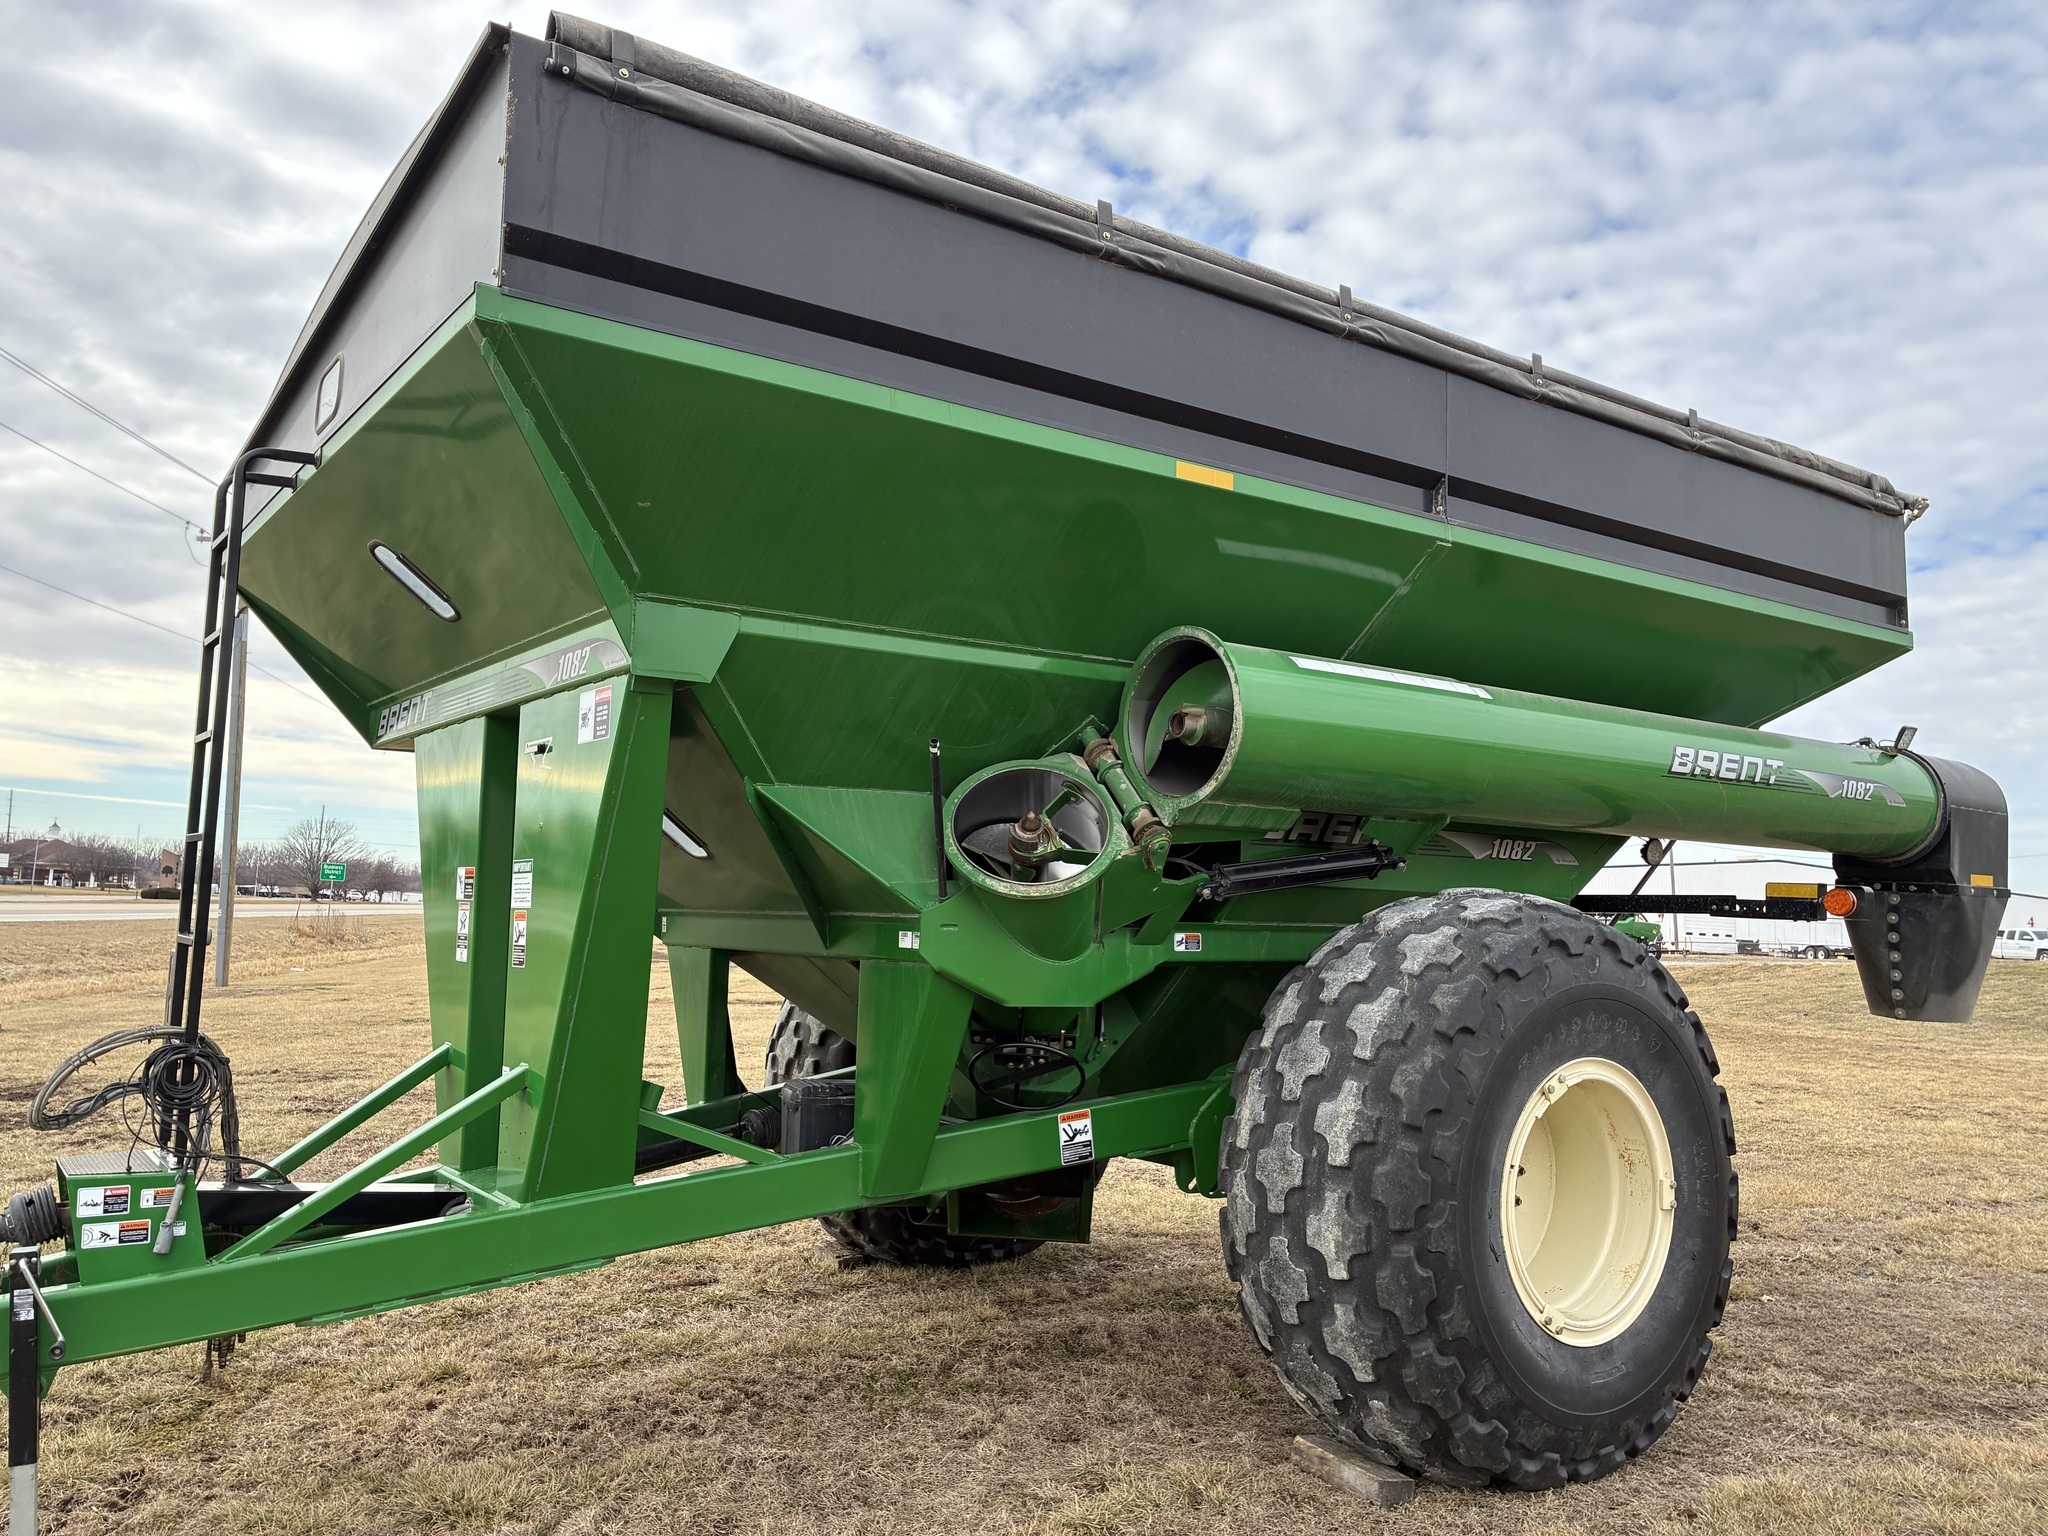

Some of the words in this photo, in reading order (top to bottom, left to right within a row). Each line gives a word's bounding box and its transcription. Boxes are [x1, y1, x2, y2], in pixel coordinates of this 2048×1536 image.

[377, 691, 433, 738] BRENT
[557, 645, 592, 682] 1082
[1668, 746, 1784, 785] BRENT
[1841, 779, 1874, 802] 1082
[1491, 838, 1537, 861] 1082
[2027, 916, 2035, 928] 4
[1066, 1112, 1089, 1120] WARNING
